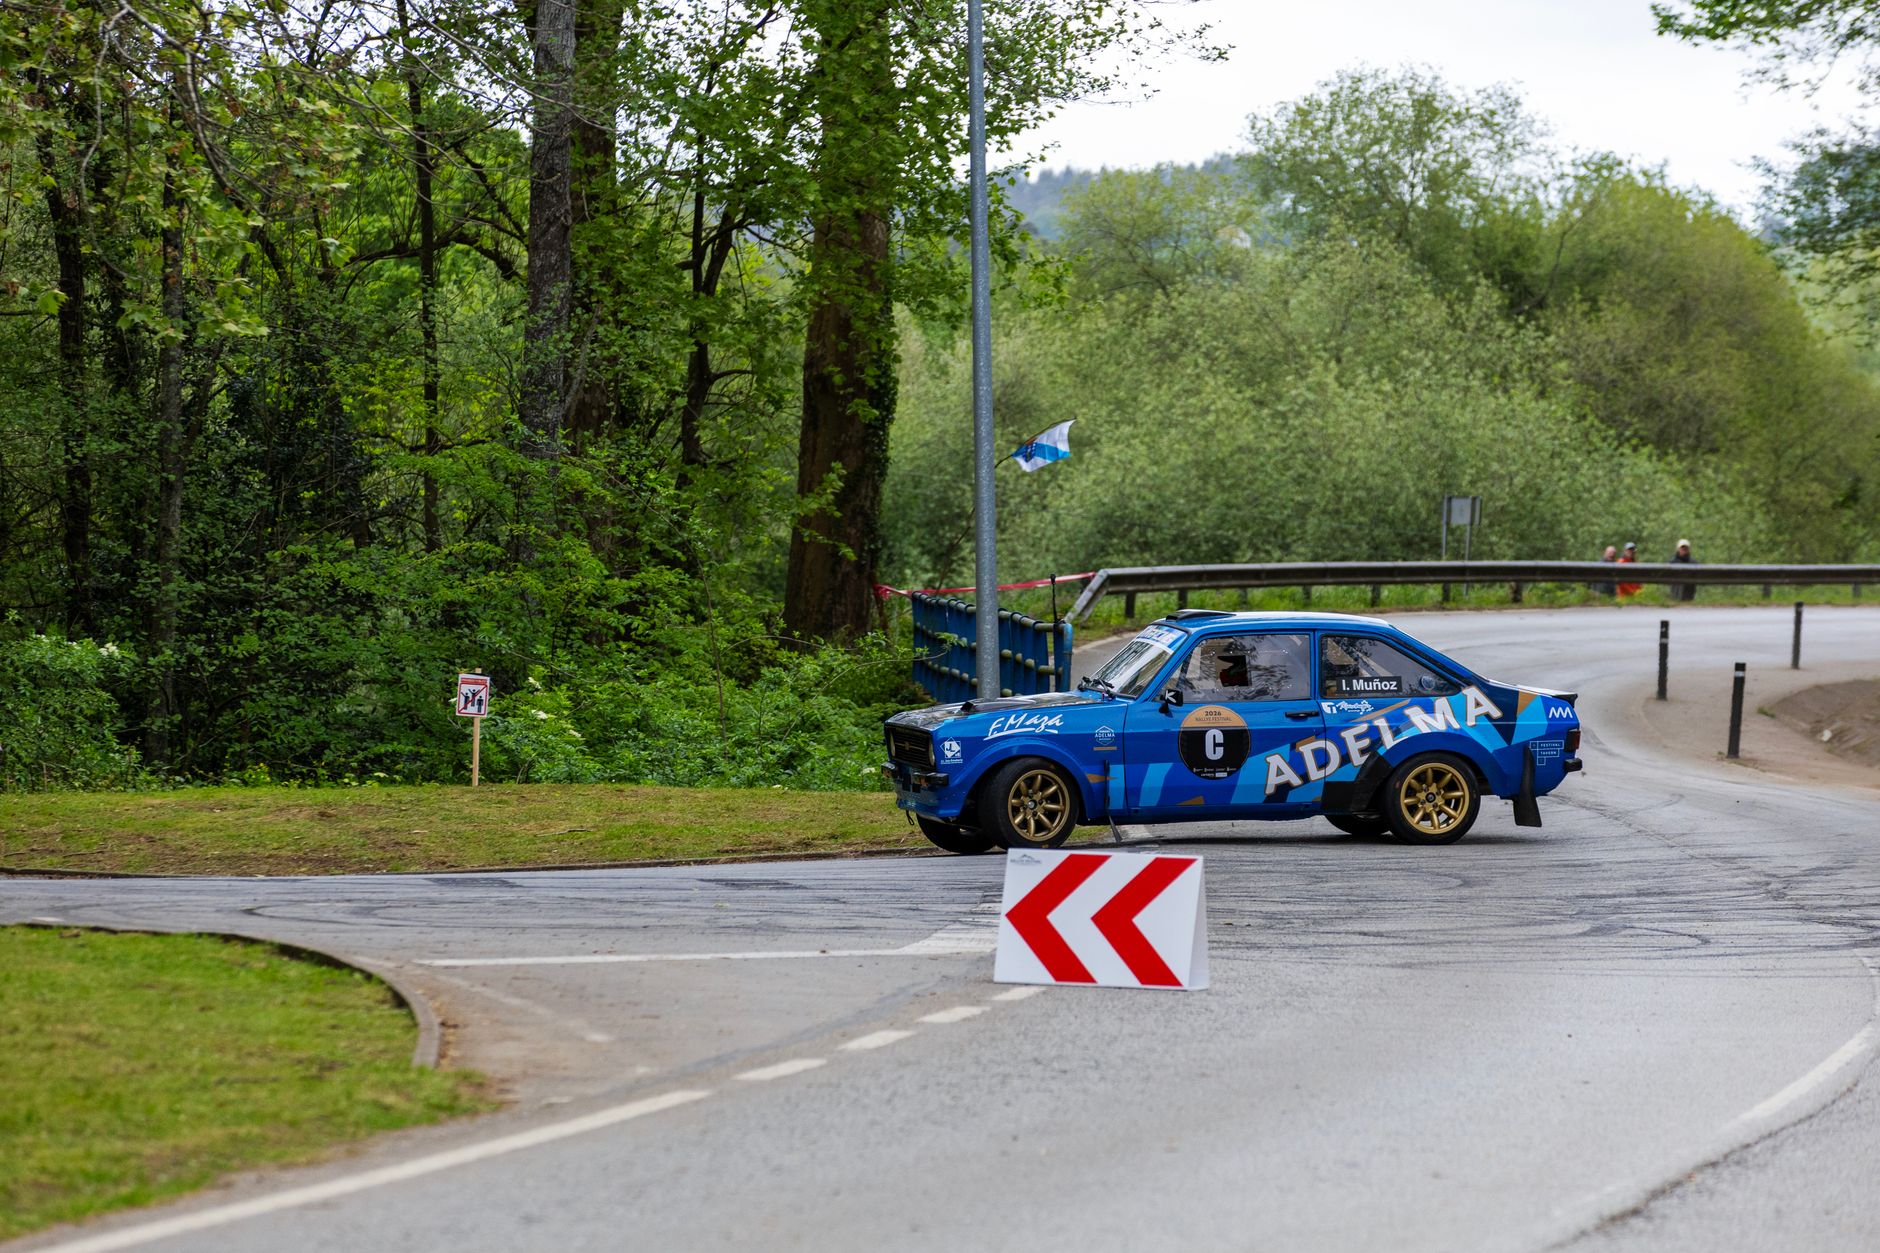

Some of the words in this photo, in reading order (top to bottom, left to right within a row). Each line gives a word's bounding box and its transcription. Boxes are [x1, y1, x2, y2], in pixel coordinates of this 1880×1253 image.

[1341, 679, 1350, 691] I.
[1352, 678, 1398, 691] Muñoz
[1205, 729, 1224, 760] C
[1264, 686, 1502, 796] ADELMA
